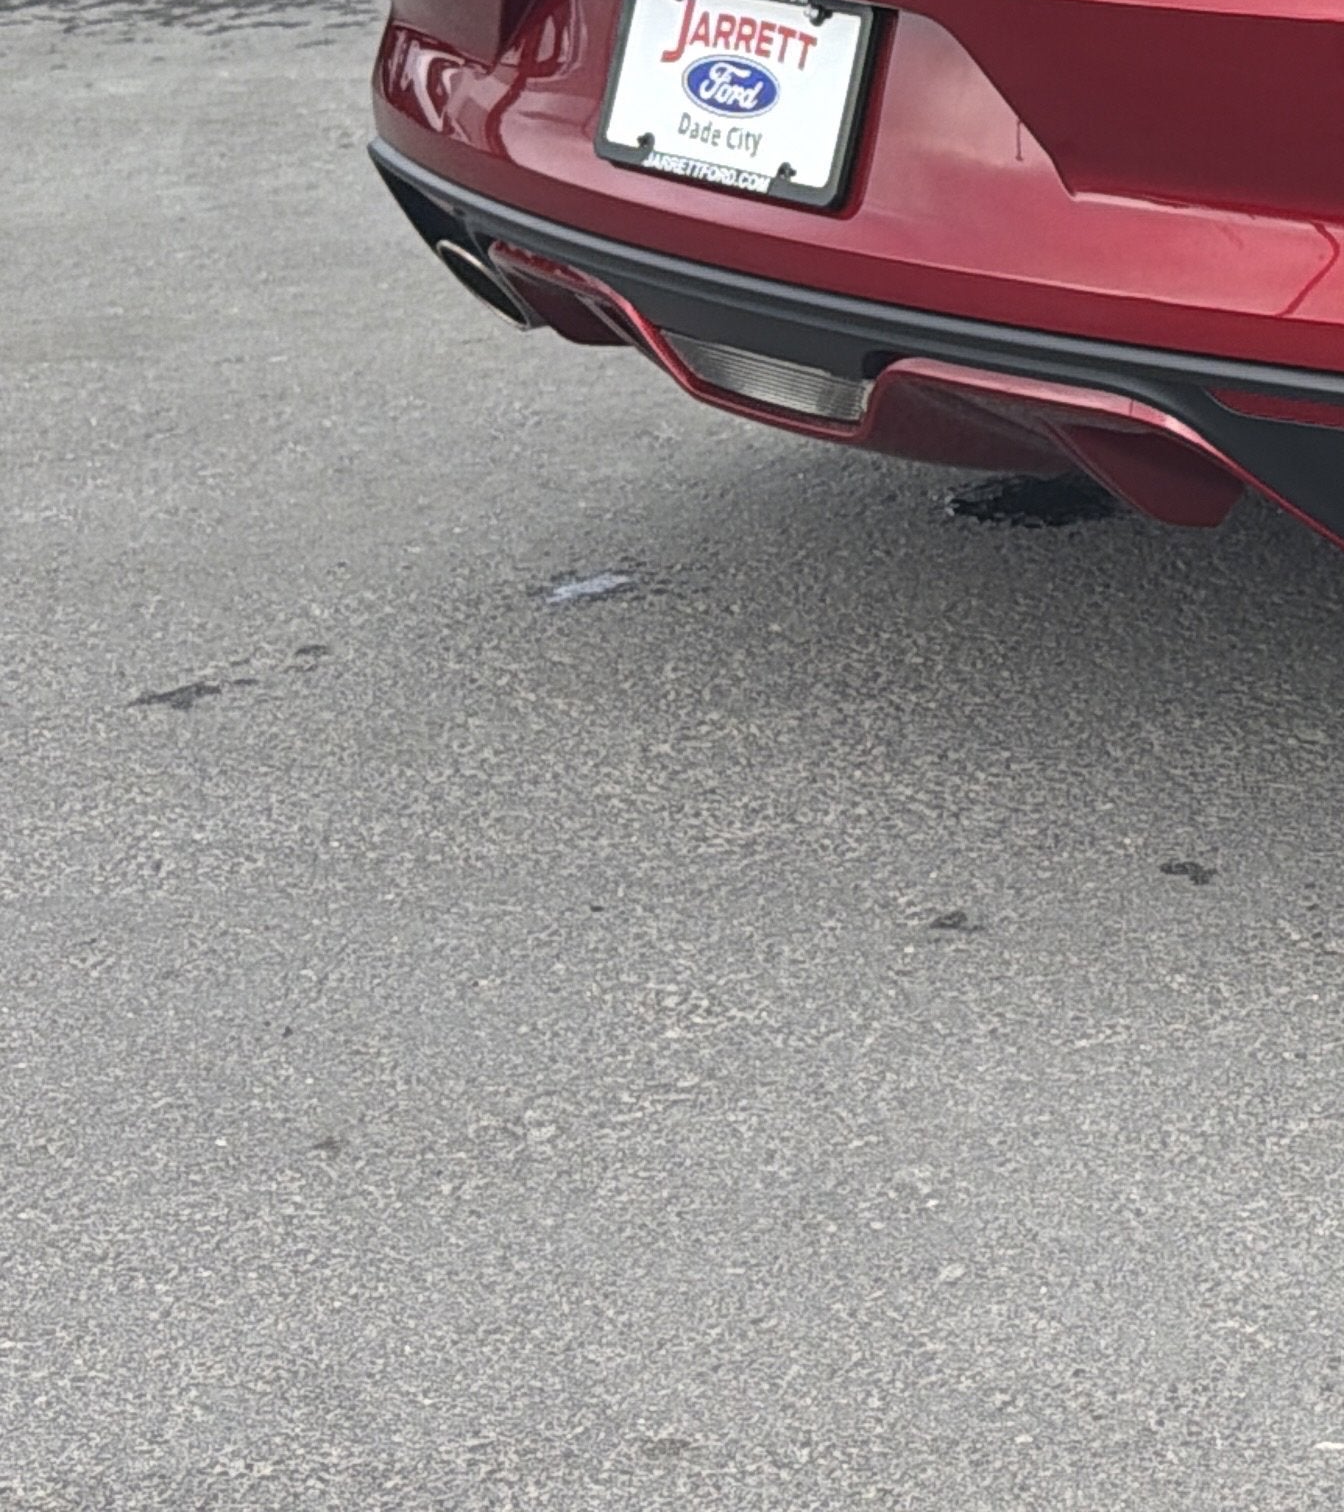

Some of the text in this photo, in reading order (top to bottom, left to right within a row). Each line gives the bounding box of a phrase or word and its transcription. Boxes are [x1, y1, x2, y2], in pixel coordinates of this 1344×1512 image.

[699, 62, 764, 110] Ford
[677, 112, 763, 158] Dade City
[642, 151, 772, 194] JARRETTFORD.COM
